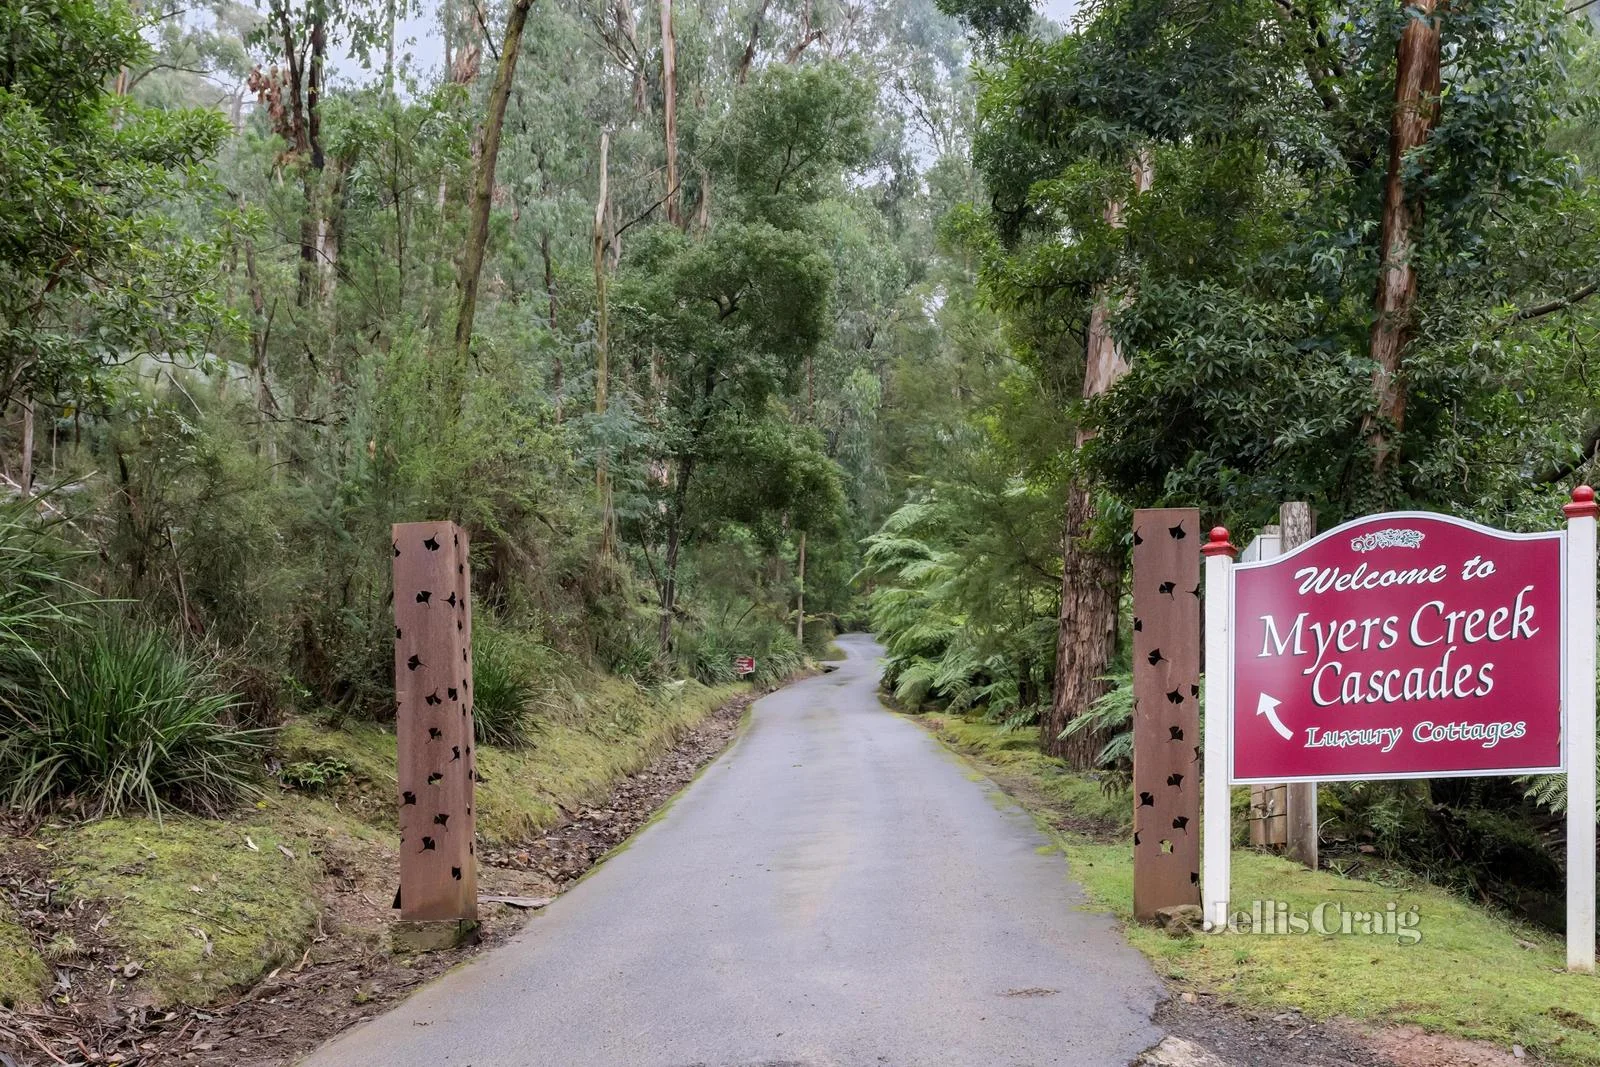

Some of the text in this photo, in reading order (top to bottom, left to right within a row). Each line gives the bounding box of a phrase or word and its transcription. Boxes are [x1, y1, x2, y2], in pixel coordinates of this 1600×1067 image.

[1294, 555, 1496, 595] Welcome to
[1258, 585, 1540, 674] Myers Creek
[1311, 646, 1495, 706] Cascades
[1304, 720, 1527, 752] Luxury Cottages
